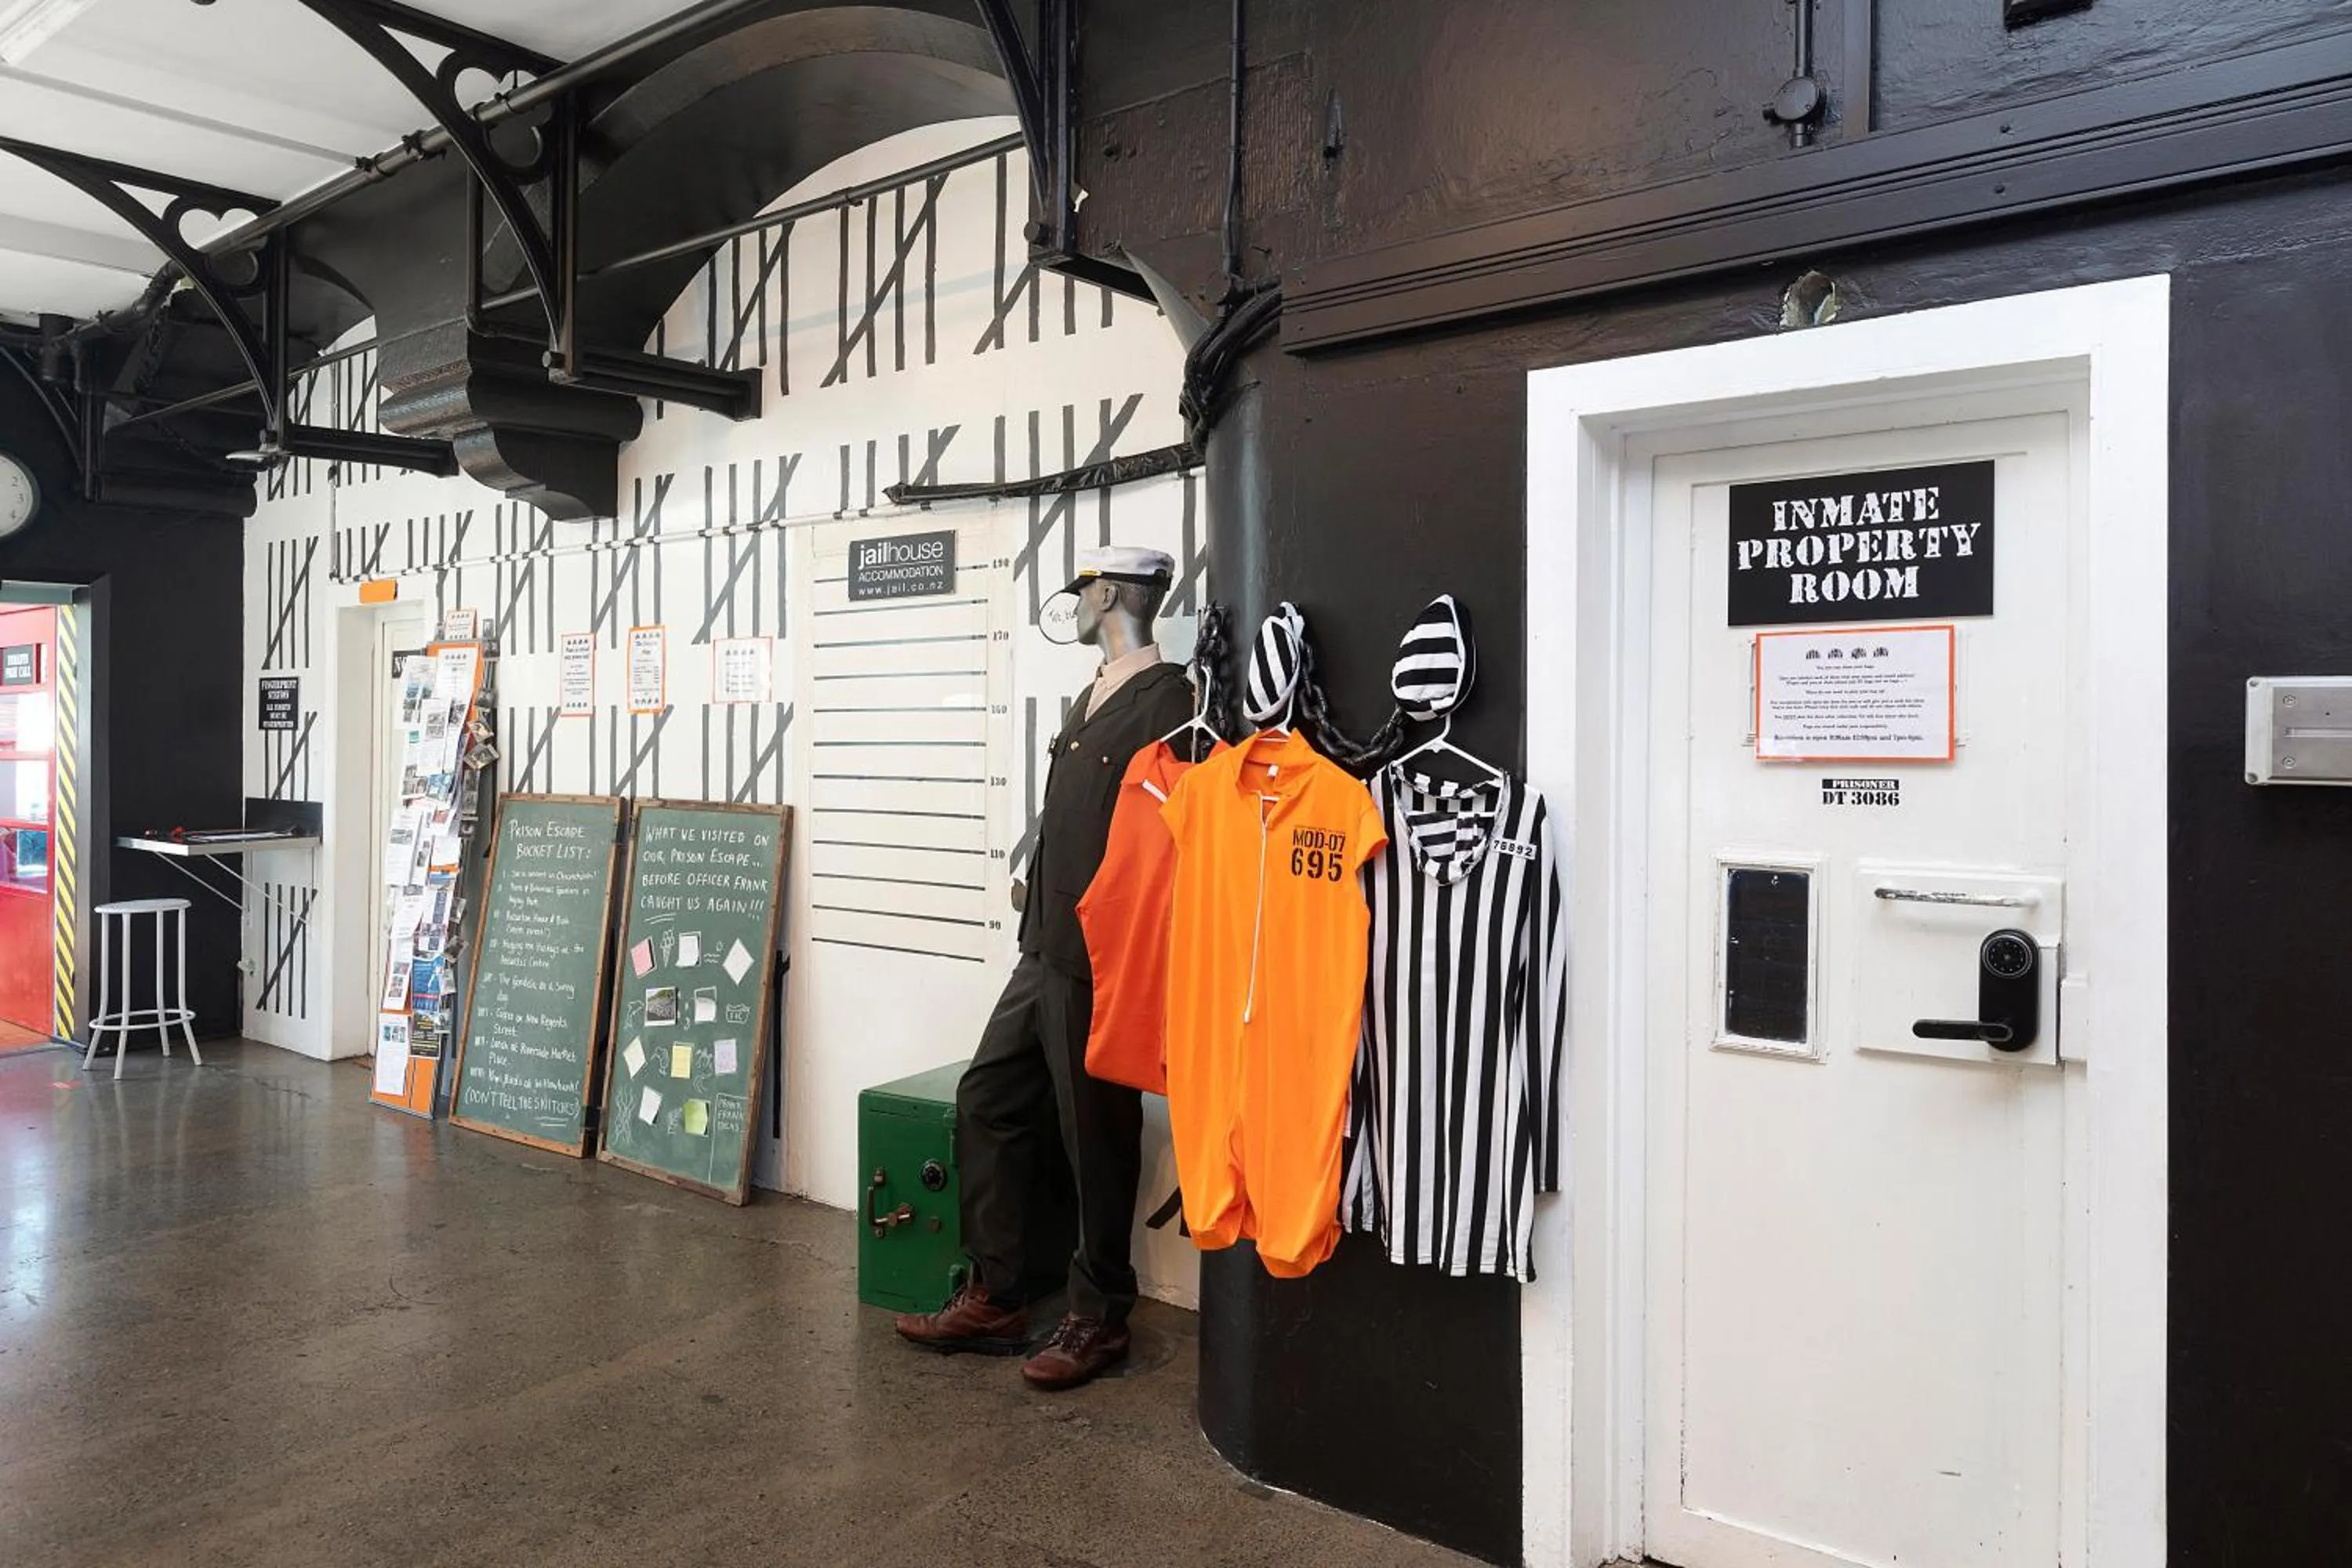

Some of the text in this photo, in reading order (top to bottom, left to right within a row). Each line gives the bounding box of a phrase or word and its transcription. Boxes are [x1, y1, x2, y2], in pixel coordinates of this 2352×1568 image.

[1773, 487, 1940, 532] INMATE
[858, 541, 943, 570] jailhouse
[1737, 523, 1981, 570] PROPERTY
[858, 564, 944, 583] ACCOMMODATION
[858, 581, 944, 595] www.jail.co.nz
[1789, 565, 1919, 604] ROOM
[993, 630, 1009, 641] 170
[1833, 780, 1896, 789] PRISONER
[1823, 791, 1900, 806] DT 3086
[510, 818, 586, 840] PRISON ESCAPE
[646, 825, 677, 844] WHAT
[702, 828, 745, 843] VISITED
[753, 833, 771, 847] ON
[1293, 829, 1346, 852] MOD-07
[516, 844, 554, 860] BUCKET
[643, 850, 666, 864] OUR
[671, 848, 706, 863] PRISON
[1291, 847, 1343, 882] 695
[642, 873, 769, 893] BEFORE OFFICER FRANK
[641, 895, 681, 910] CAUGHT
[687, 897, 701, 910] US
